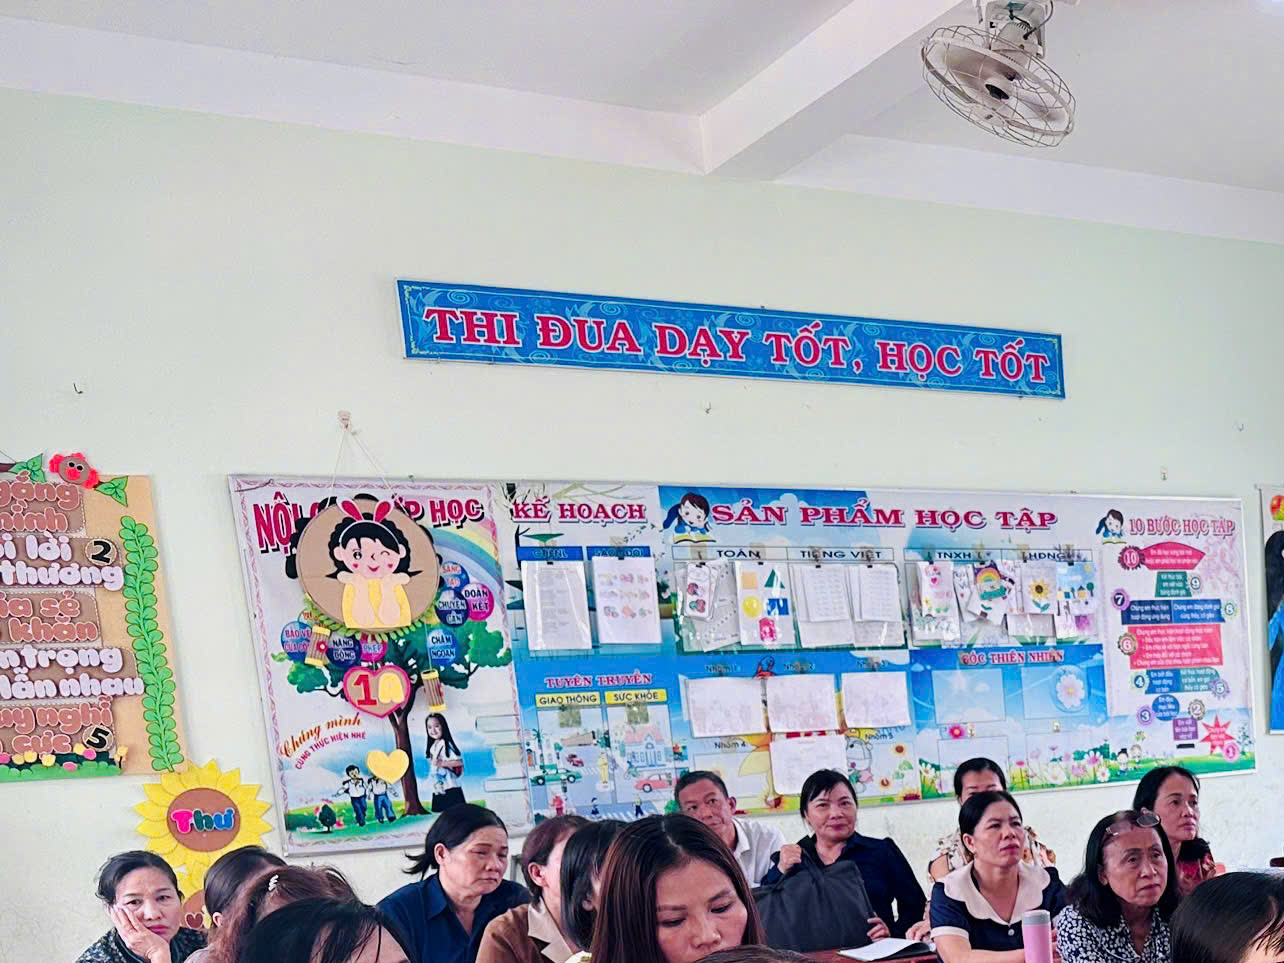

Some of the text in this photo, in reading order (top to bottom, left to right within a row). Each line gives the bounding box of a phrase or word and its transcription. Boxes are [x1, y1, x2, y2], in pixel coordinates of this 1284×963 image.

[424, 307, 1050, 383] THI ĐUA DẠY TỐT, HỌC TỐT
[429, 499, 487, 529] HỌC
[512, 495, 648, 528] KẾ HOẠCH
[711, 497, 1058, 534] SẢN PHẨM HỌC TẬP
[1129, 518, 1146, 536] 10
[1183, 518, 1210, 540] HỌC
[25, 530, 73, 562] lời
[91, 540, 112, 564] 2
[936, 552, 972, 560] TNXH
[1125, 551, 1137, 565] 10
[1192, 577, 1200, 589] 9
[40, 589, 81, 618] sẻ
[1115, 594, 1124, 605] 7
[1226, 604, 1234, 615] 8
[8, 615, 99, 643] khăn
[1123, 638, 1132, 649] 6
[20, 643, 123, 675] trọng
[988, 648, 1026, 666] THIÊN
[58, 672, 145, 698] nhau
[543, 673, 594, 689] TUYÊN
[1134, 675, 1144, 688] 4
[1216, 683, 1225, 694] 5
[539, 692, 598, 705] GIAO THÔNG
[1191, 702, 1202, 715] 2
[326, 711, 361, 731] mình
[1141, 710, 1150, 721] 3
[86, 727, 110, 750] 5
[170, 807, 236, 835] Thư
